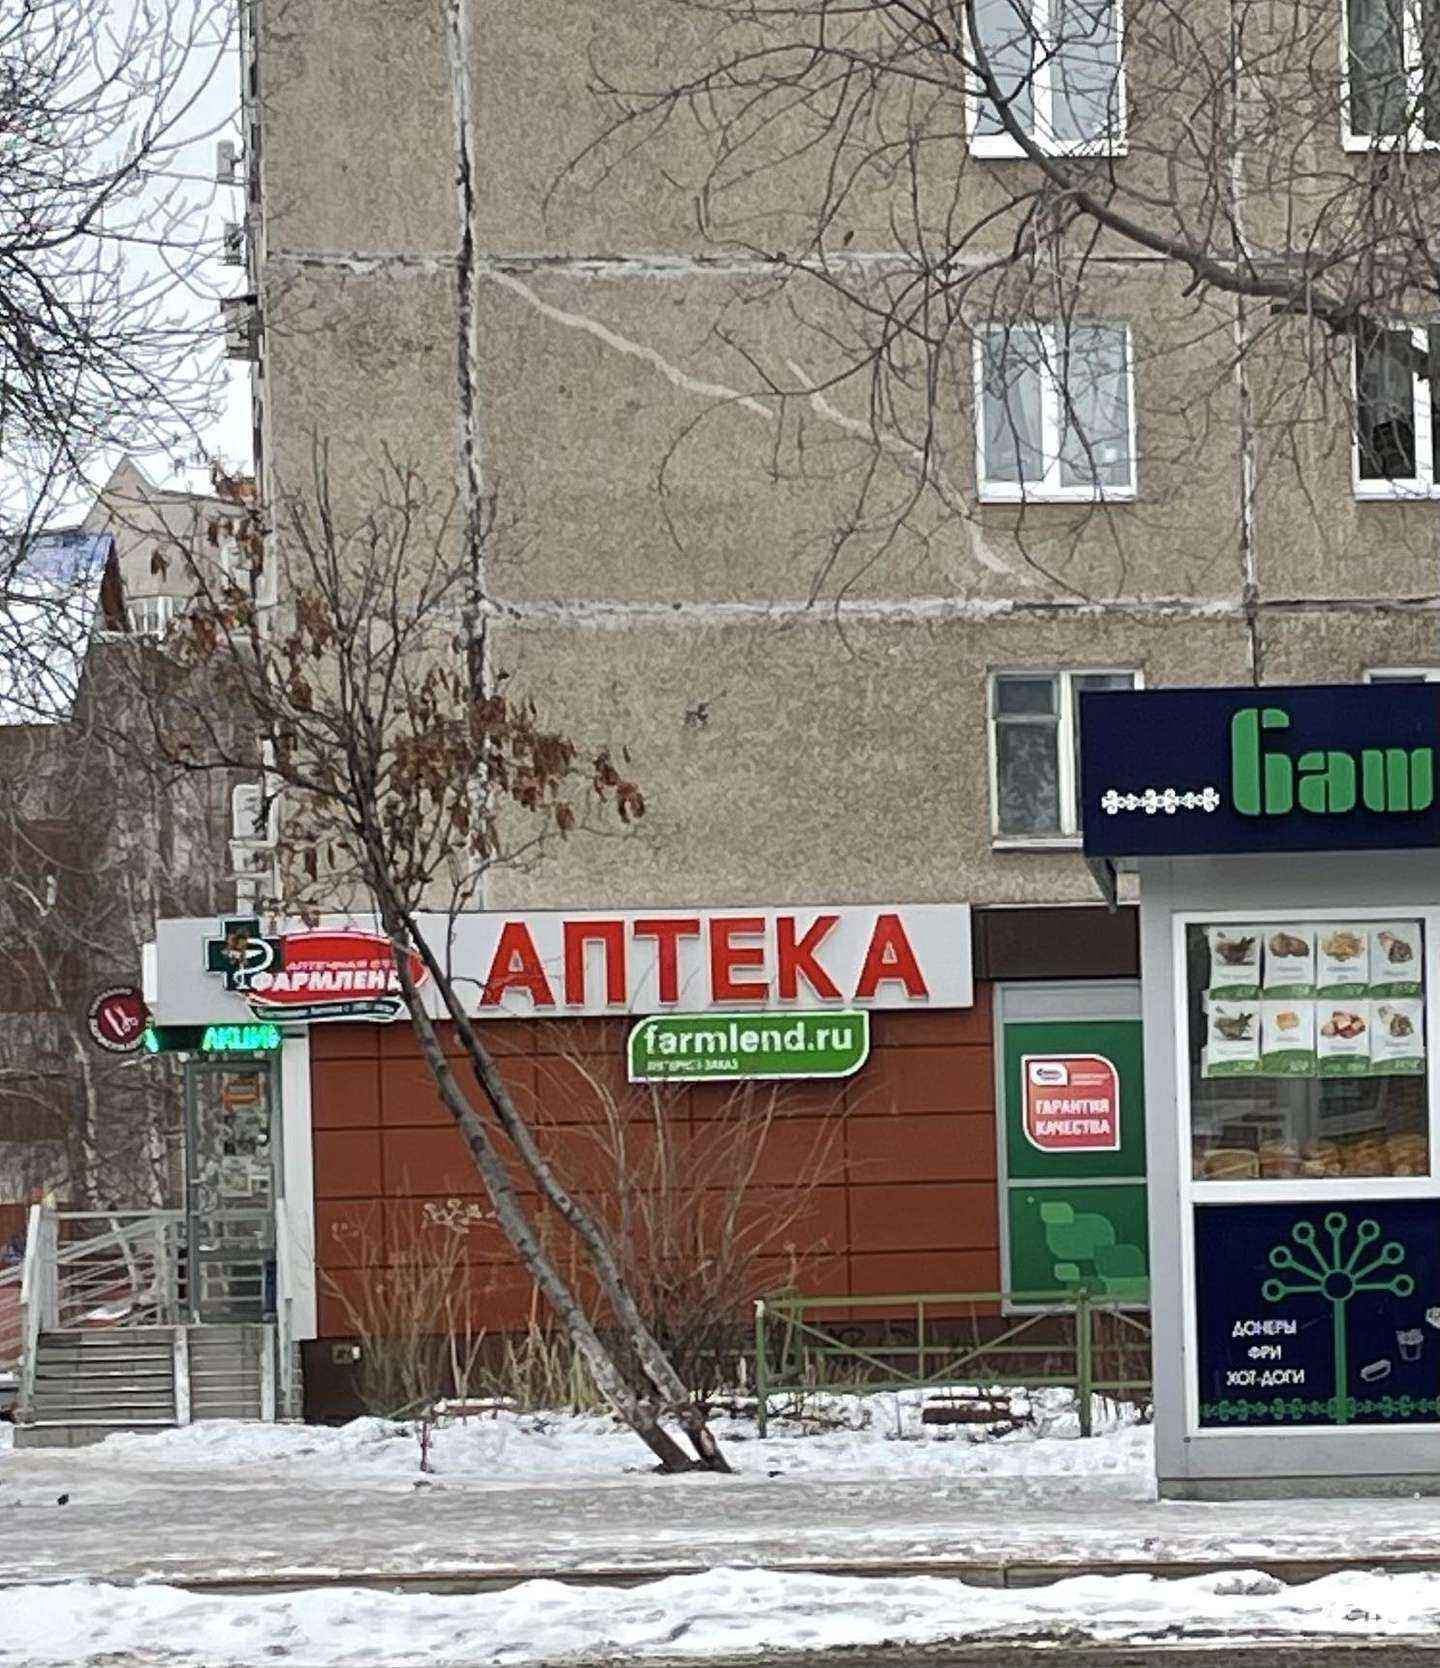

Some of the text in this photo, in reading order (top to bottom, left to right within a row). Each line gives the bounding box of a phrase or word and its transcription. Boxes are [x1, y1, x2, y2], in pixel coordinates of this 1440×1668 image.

[478, 913, 930, 1008] АПТЕКА
[644, 1021, 853, 1054] farmlend.ru
[1035, 1098, 1110, 1115] ГАРАНТИЯ
[1034, 1119, 1111, 1136] КАЧЕСТВА
[1231, 1319, 1297, 1337] ДОНЕРЫ
[1248, 1345, 1282, 1360] ФРИ
[1226, 1369, 1305, 1387] ХОТ-ДОГИ
